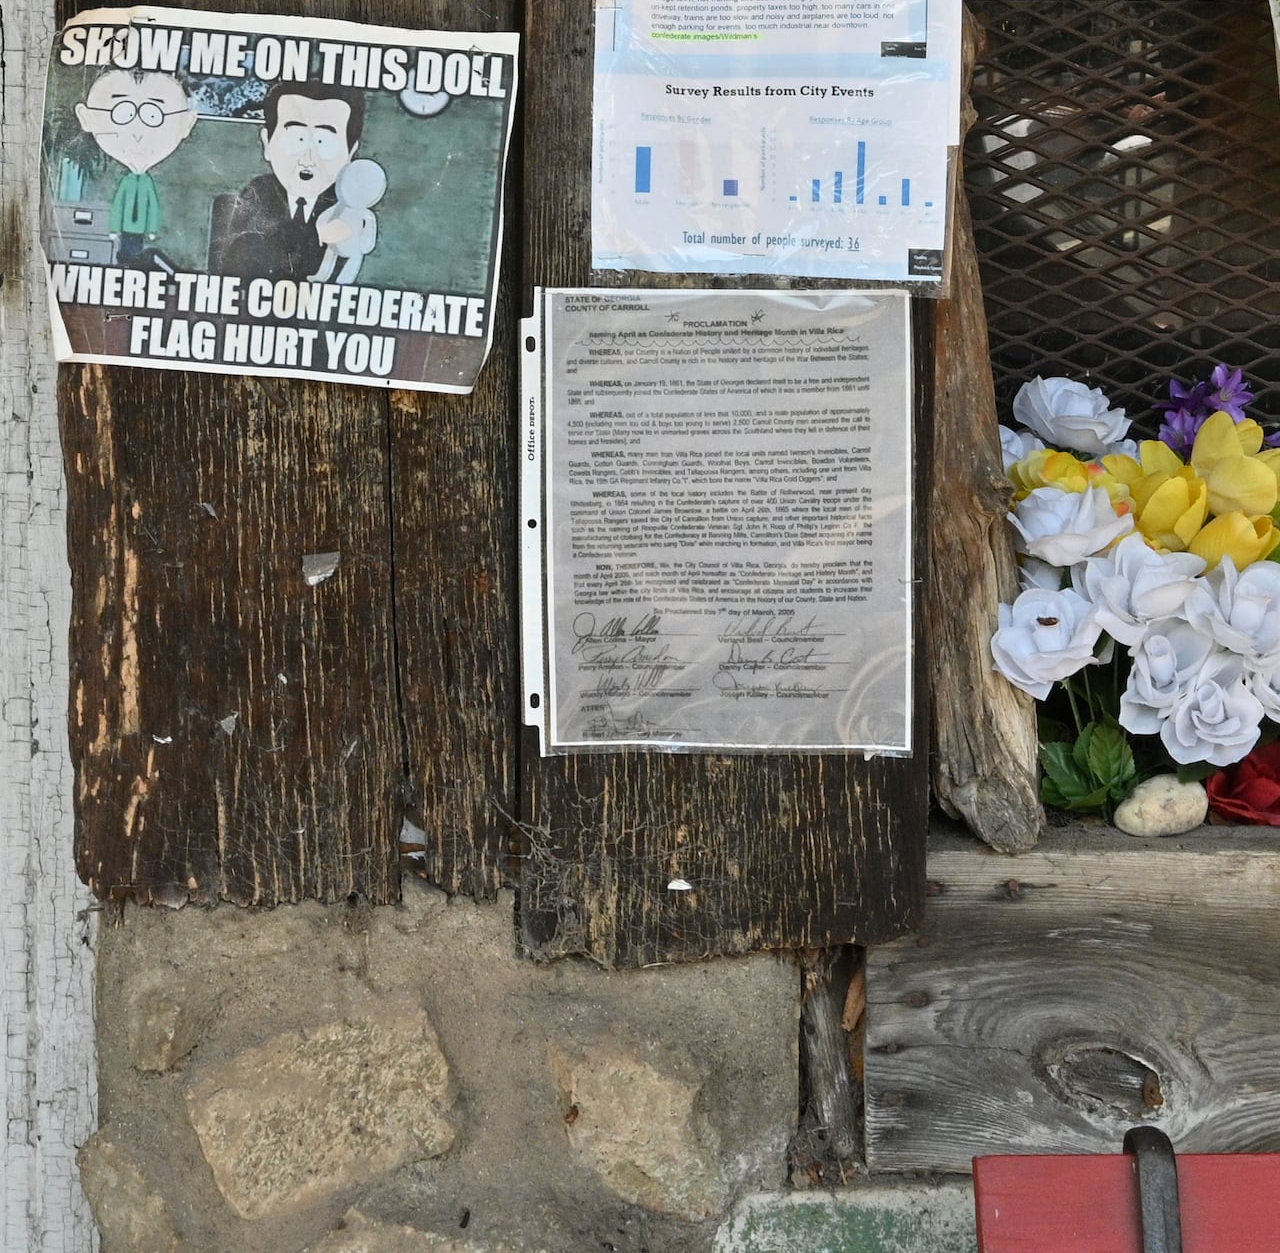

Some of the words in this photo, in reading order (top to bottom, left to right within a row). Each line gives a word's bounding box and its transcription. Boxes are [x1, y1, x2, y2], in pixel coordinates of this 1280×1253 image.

[59, 25, 183, 72] SHOW
[188, 32, 248, 78] ME
[254, 37, 310, 83] ON
[317, 42, 409, 91] THIS
[412, 48, 507, 99] DOLL
[665, 84, 710, 99] Survey
[713, 85, 761, 97] Results
[765, 85, 797, 97] from
[800, 85, 828, 98] City
[831, 86, 875, 98] Events
[683, 231, 706, 244] Total
[710, 233, 746, 246] number
[751, 233, 762, 246] of
[766, 234, 796, 249] people
[801, 236, 844, 250] surveyed:
[848, 237, 860, 251] 36
[50, 264, 168, 308] WHERE
[172, 273, 241, 315] THE
[247, 278, 485, 338] CONFEDERATE
[129, 315, 218, 362] FLAG
[222, 323, 319, 370] HURT
[324, 331, 396, 376] YOU
